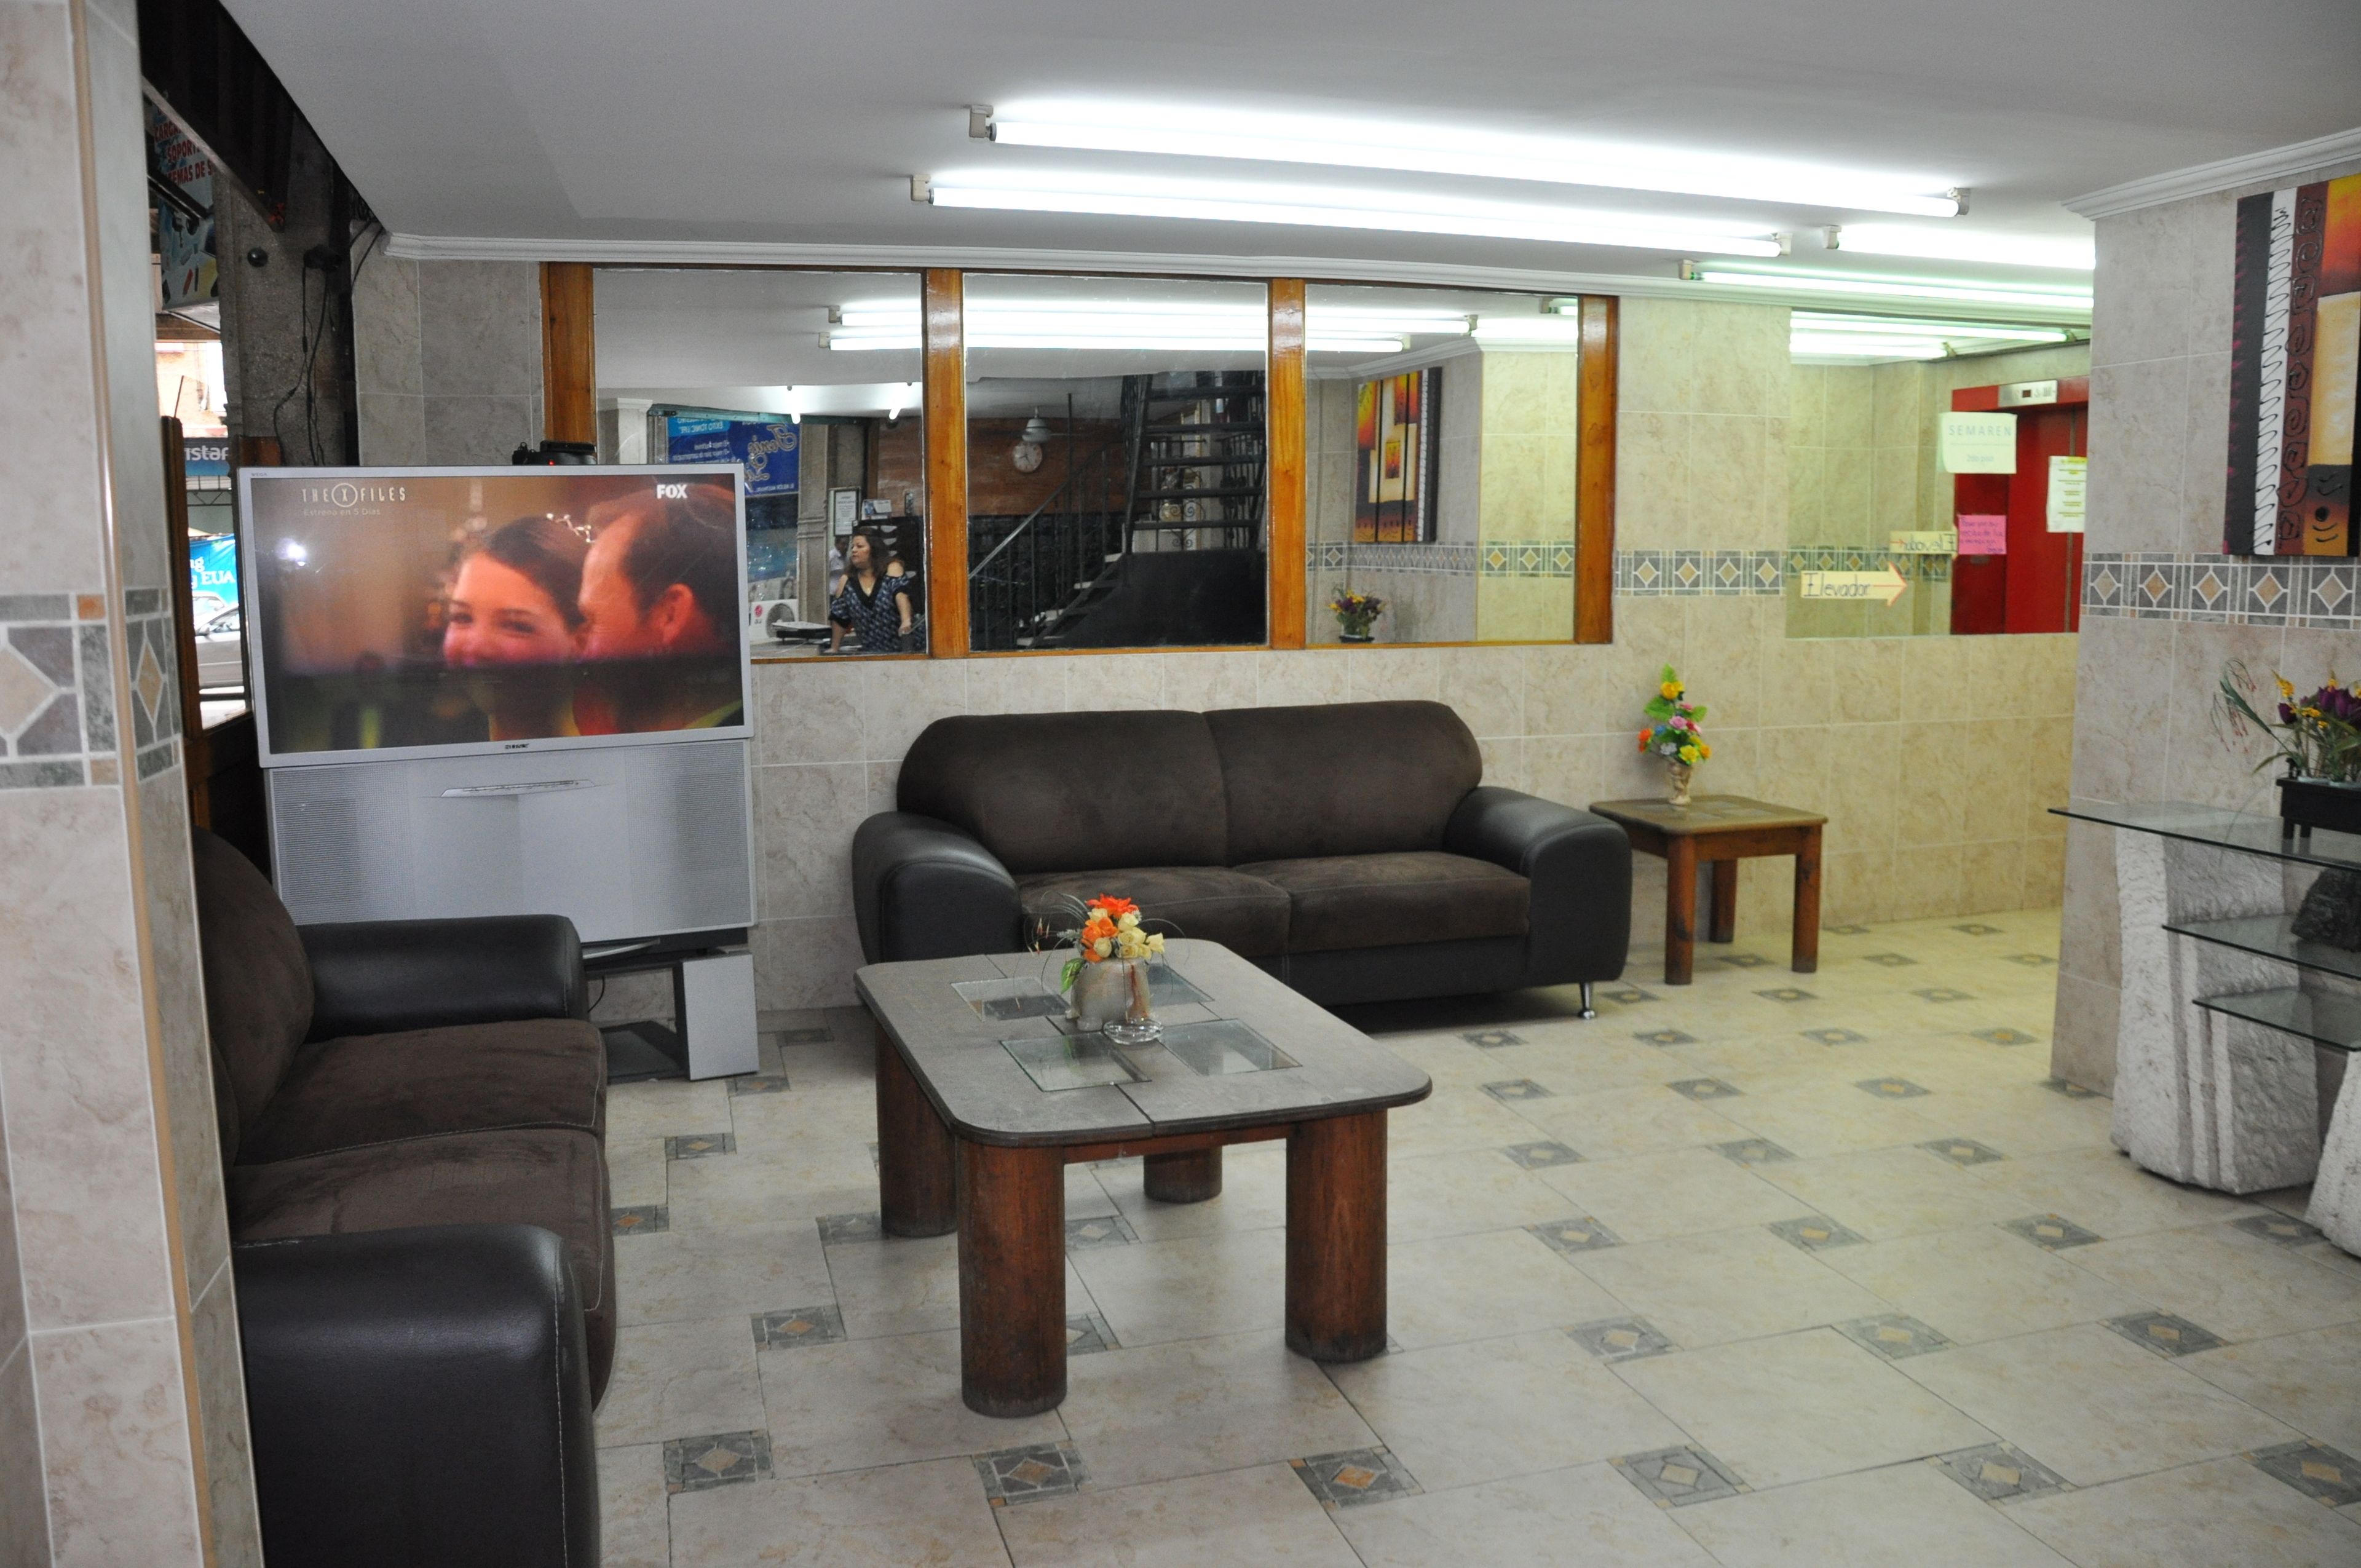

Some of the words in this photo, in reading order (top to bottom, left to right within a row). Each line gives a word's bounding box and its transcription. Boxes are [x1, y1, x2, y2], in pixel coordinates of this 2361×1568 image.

[194, 160, 205, 180] DE
[1948, 424, 2012, 437] SEMAREN
[301, 488, 330, 502] THE
[360, 486, 406, 502] FILES
[657, 483, 688, 499] FOX
[201, 570, 236, 585] EUA
[1803, 572, 1870, 597] Elevador
